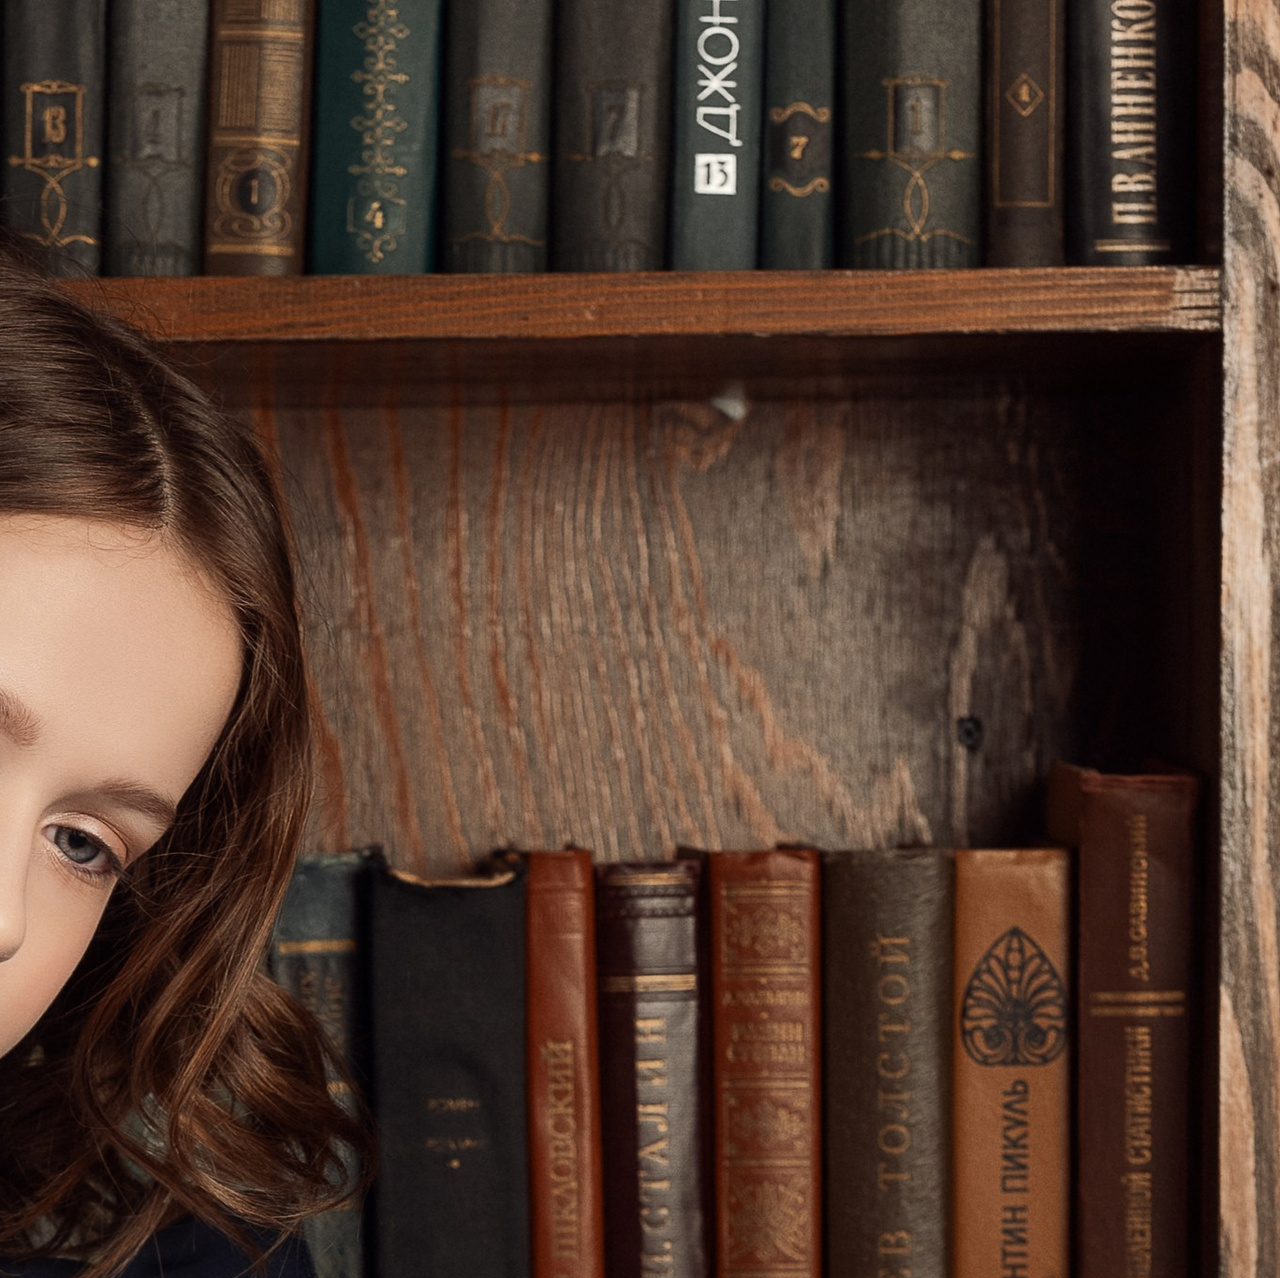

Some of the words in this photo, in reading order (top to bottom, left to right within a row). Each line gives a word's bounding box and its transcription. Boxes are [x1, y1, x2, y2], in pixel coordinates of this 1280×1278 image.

[704, 161, 729, 188] 13
[789, 134, 809, 160] 7
[871, 933, 912, 1192] ТОЛСТОЙ
[542, 1038, 578, 1262] ШКЛОВСКИЙ
[1000, 1077, 1031, 1194] ПИКУЛЬ
